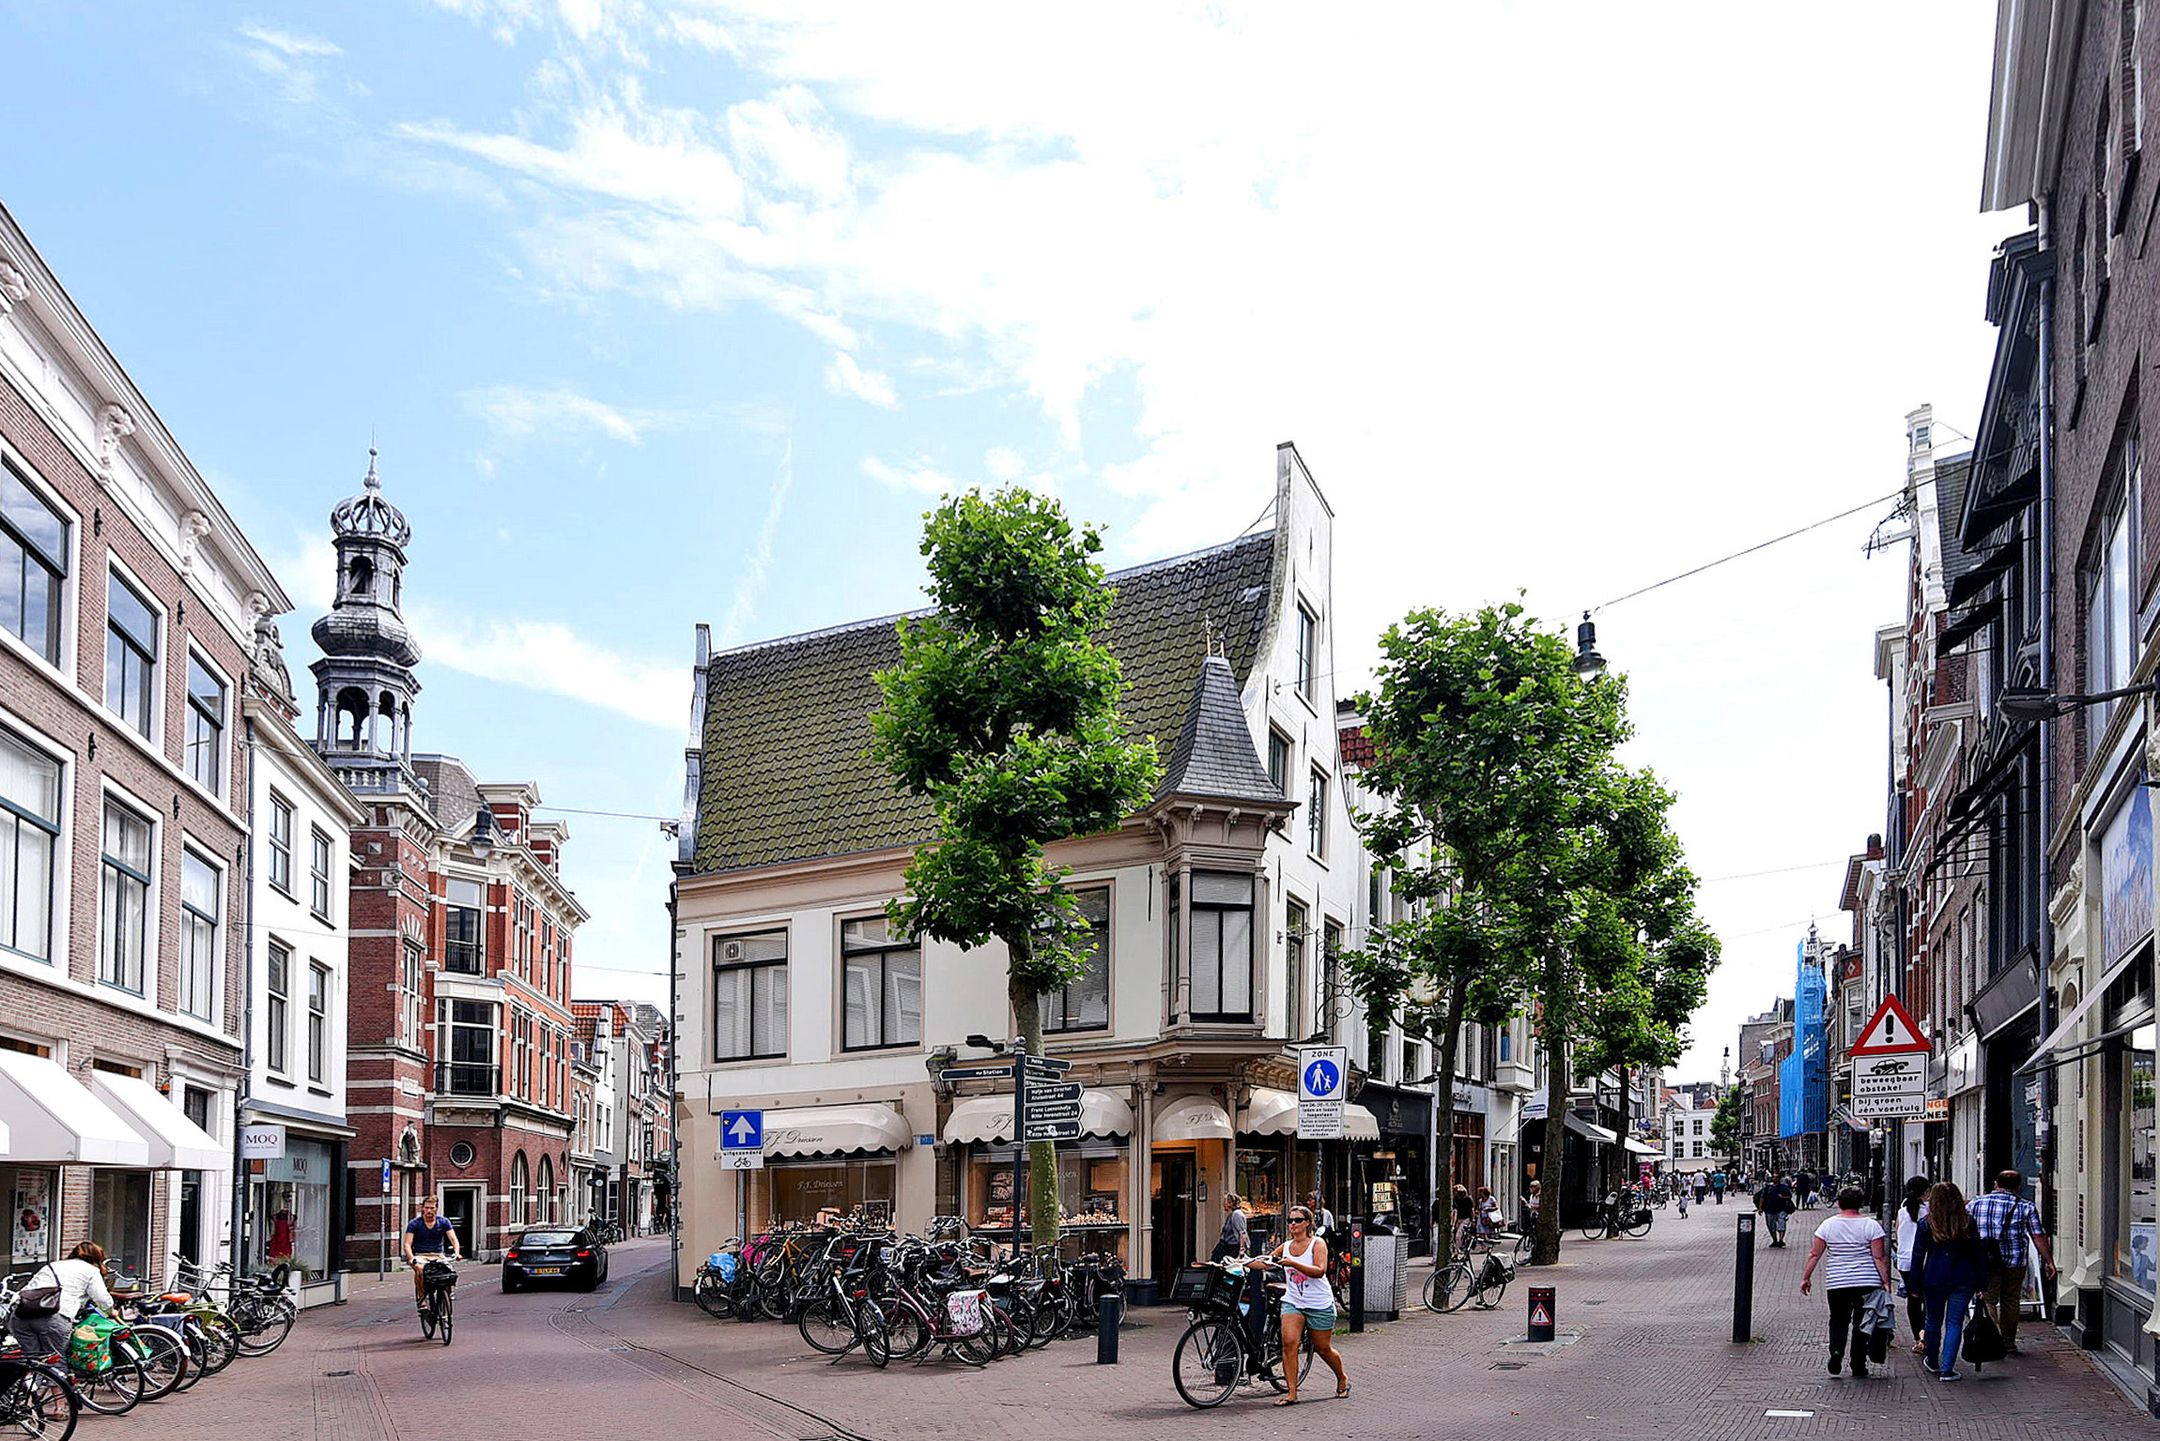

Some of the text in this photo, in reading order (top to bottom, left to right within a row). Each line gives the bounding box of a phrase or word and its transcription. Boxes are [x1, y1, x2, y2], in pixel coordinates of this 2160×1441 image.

[1860, 1076, 1918, 1084] beweegbaar
[1860, 1085, 1901, 1093] obstakel
[1858, 1097, 1901, 1106] bij groen
[1926, 1100, 1949, 1108] NGE
[1878, 1104, 1920, 1113] voertuig
[246, 1134, 278, 1144] MOQ
[785, 1129, 823, 1144] Driessen
